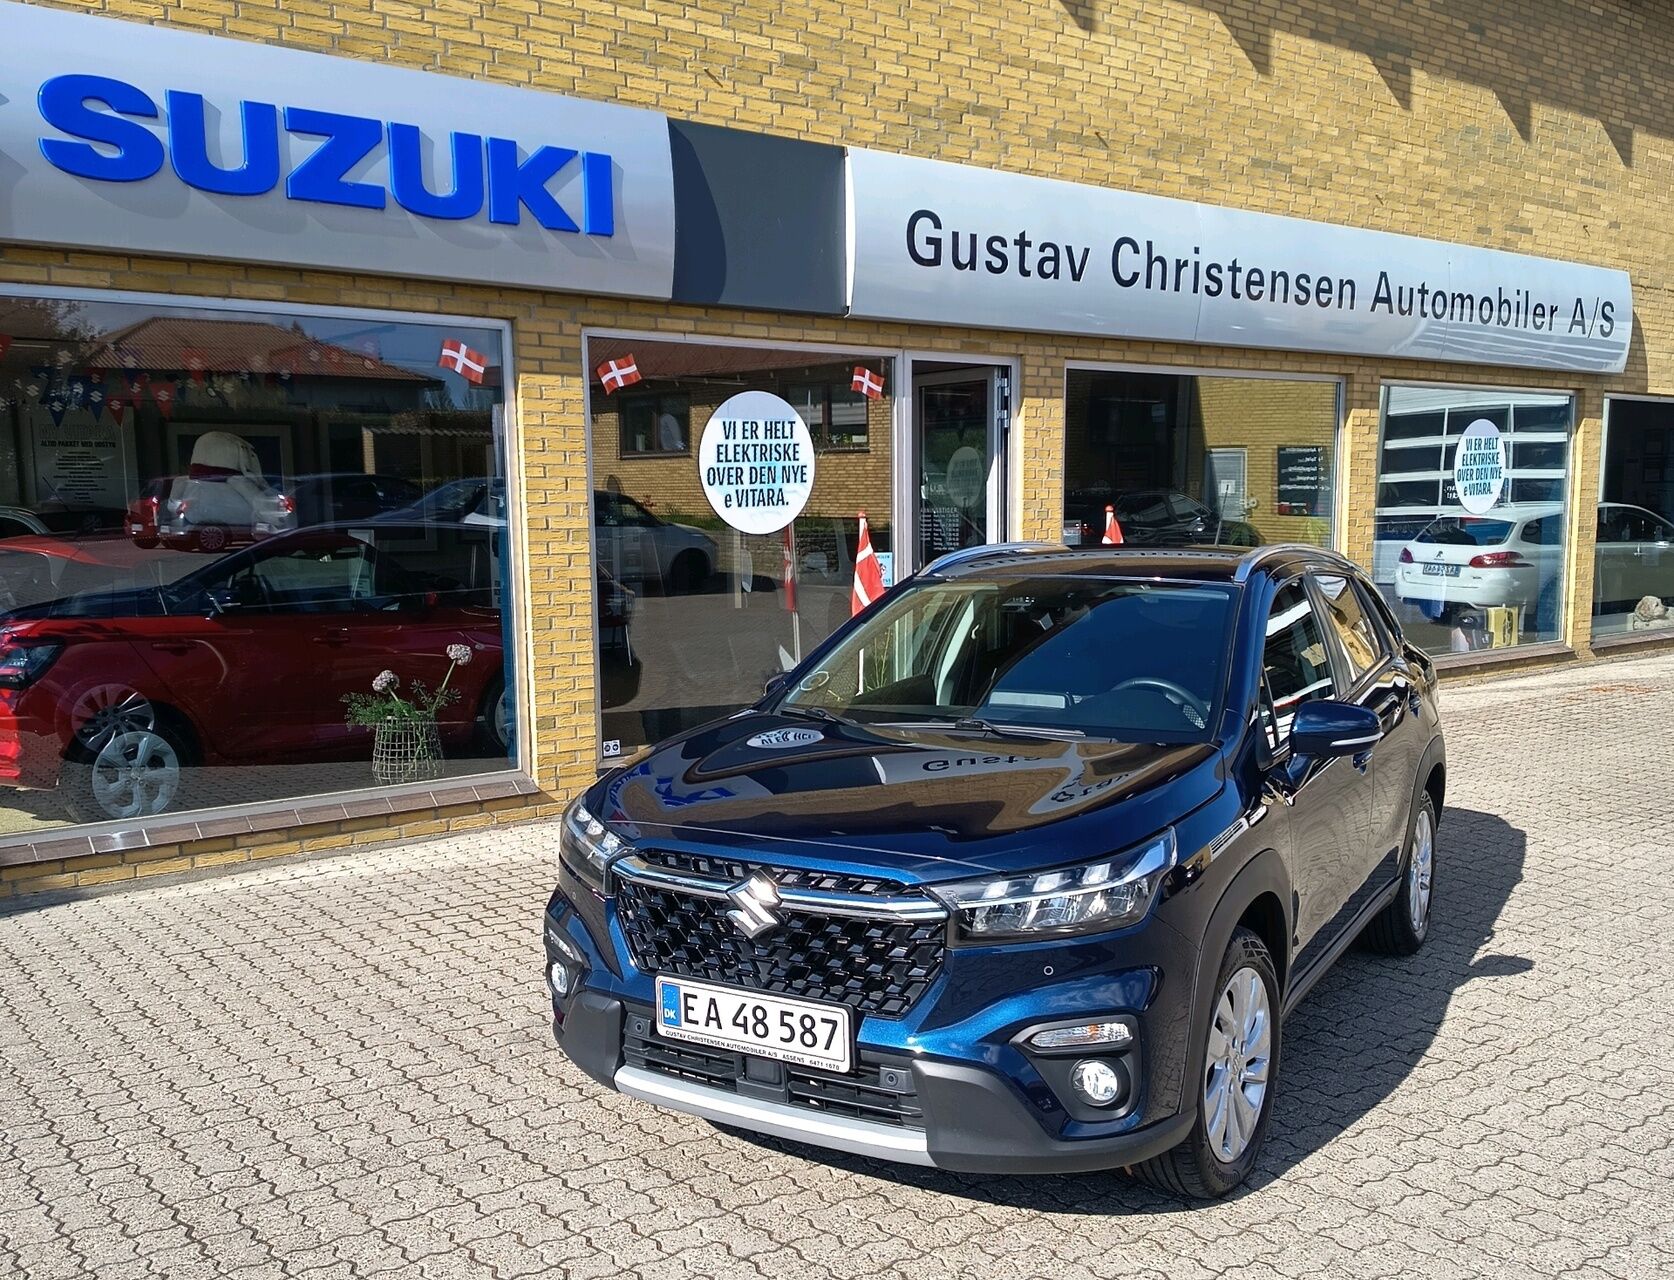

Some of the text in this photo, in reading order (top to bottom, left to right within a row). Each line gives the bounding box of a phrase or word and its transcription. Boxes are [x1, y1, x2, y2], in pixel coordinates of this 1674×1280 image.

[38, 74, 615, 237] SUZUKI
[906, 209, 1616, 339] Gustav Christensen Automobiler A/S
[722, 420, 796, 440] VI ER HELT
[716, 443, 800, 463] ELEKTRISKE
[1465, 437, 1499, 451] VI ER HELT
[1462, 452, 1500, 466] ELEKTRISKE
[706, 464, 808, 486] OVER DEN NYE
[1457, 466, 1503, 482] OVER DEN NYE
[724, 487, 789, 508] e VITARA.
[1468, 482, 1493, 496] VITARA.
[664, 1008, 677, 1020] DK
[683, 992, 838, 1051] EA 48 587
[665, 1030, 686, 1039] GUSTAV
[687, 1034, 725, 1047] CHRISTENSEN
[726, 1043, 767, 1055] AUTOMOBILER
[768, 1050, 778, 1058] A/S
[782, 1054, 805, 1063] ASSENS
